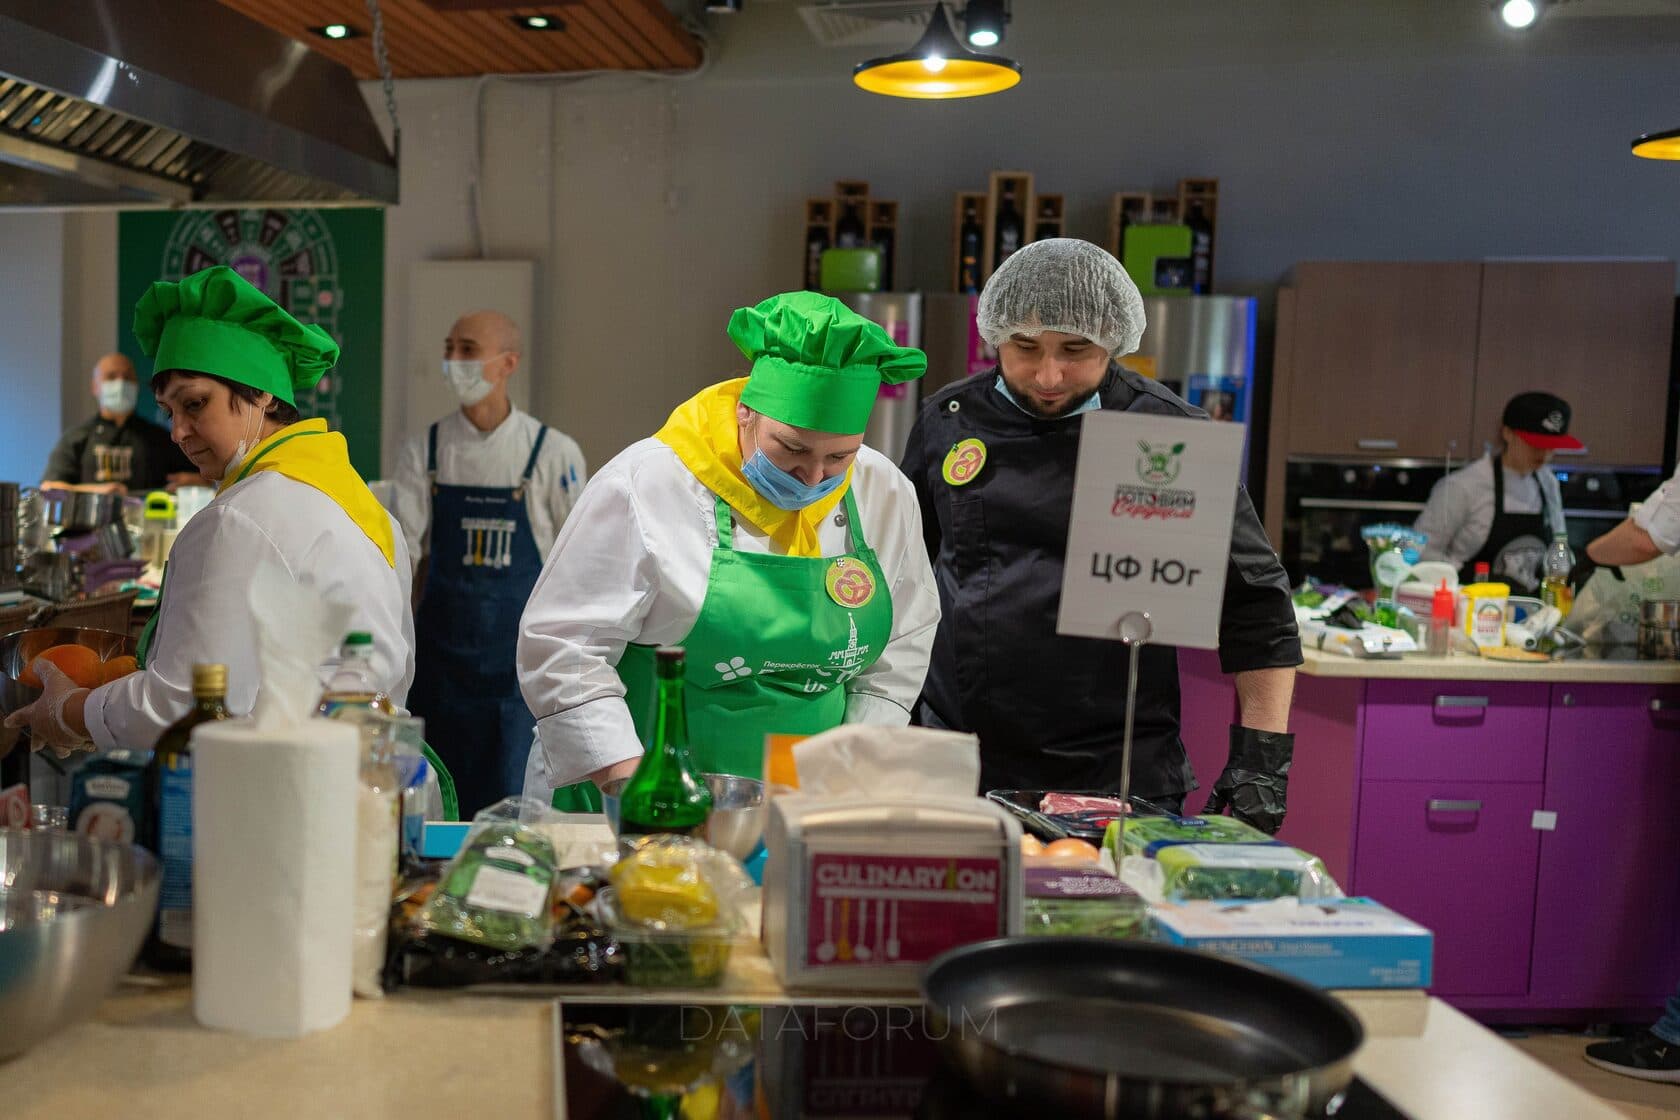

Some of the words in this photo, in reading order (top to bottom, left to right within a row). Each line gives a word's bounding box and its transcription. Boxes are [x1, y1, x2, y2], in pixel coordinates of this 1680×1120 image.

[1091, 551, 1141, 583] ЦФ
[1151, 557, 1202, 587] Юг
[816, 862, 947, 890] CULINARY
